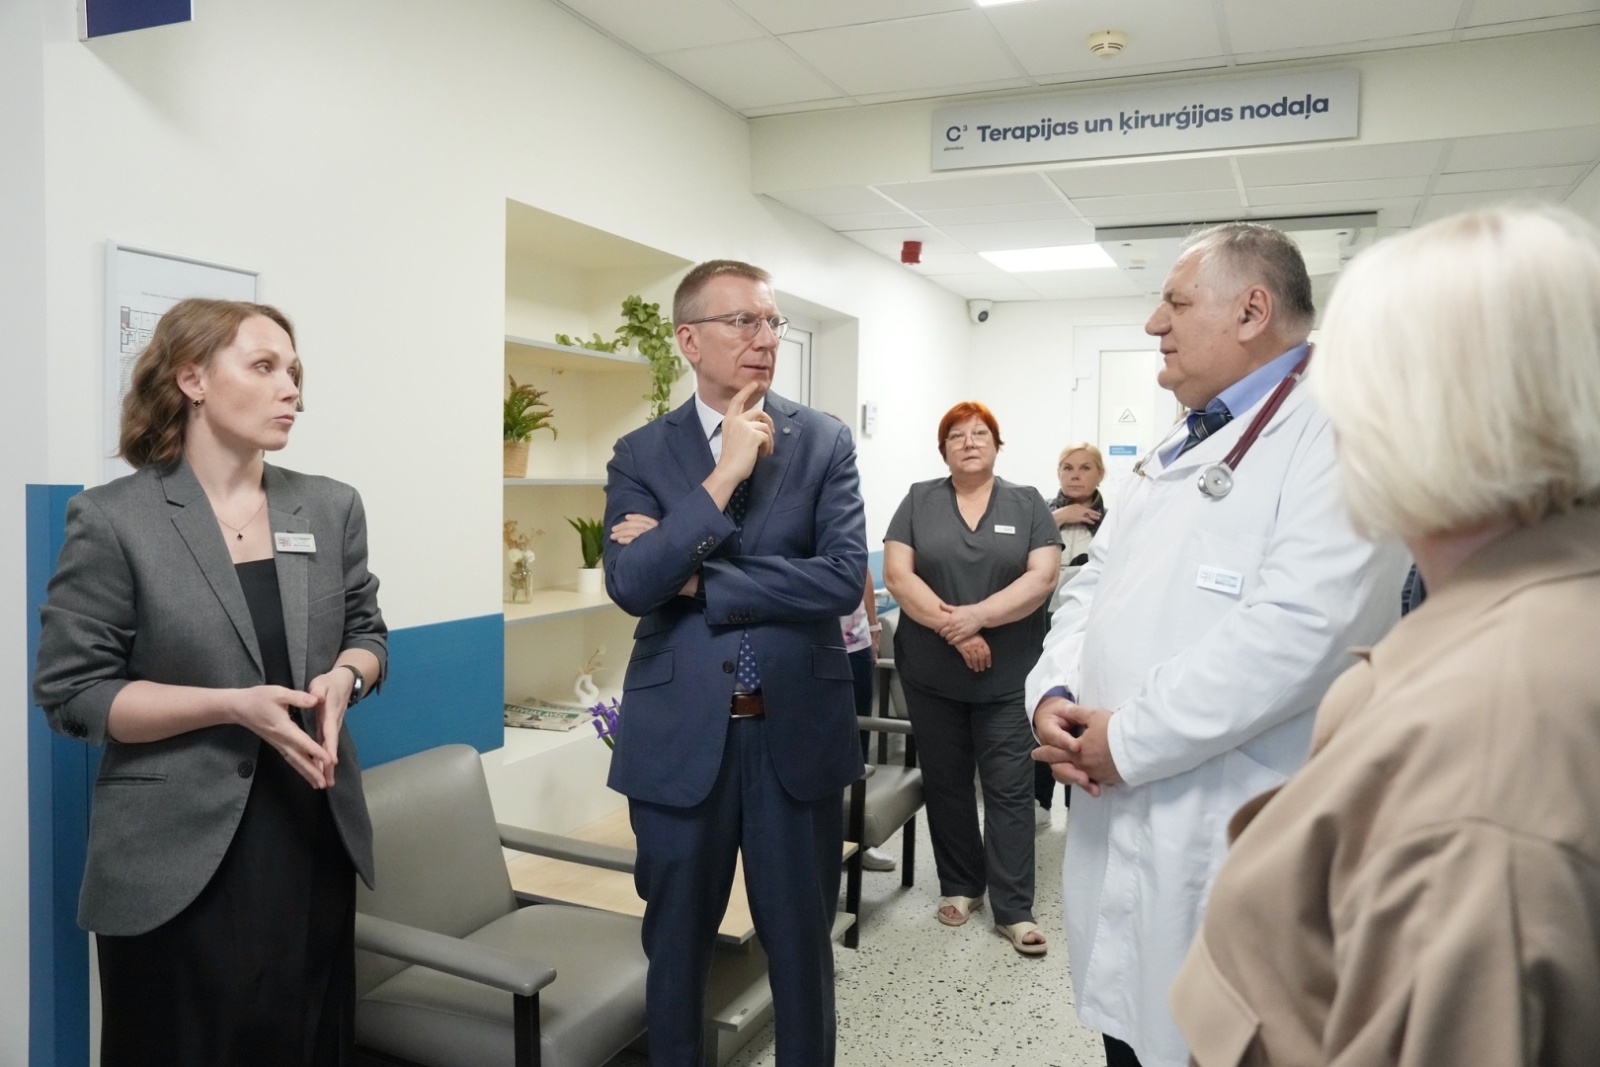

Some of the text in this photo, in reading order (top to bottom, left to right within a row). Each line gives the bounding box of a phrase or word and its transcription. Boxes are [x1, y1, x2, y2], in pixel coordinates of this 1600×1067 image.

[977, 94, 1329, 142] Terapijas un ķirurģijas nodaļa
